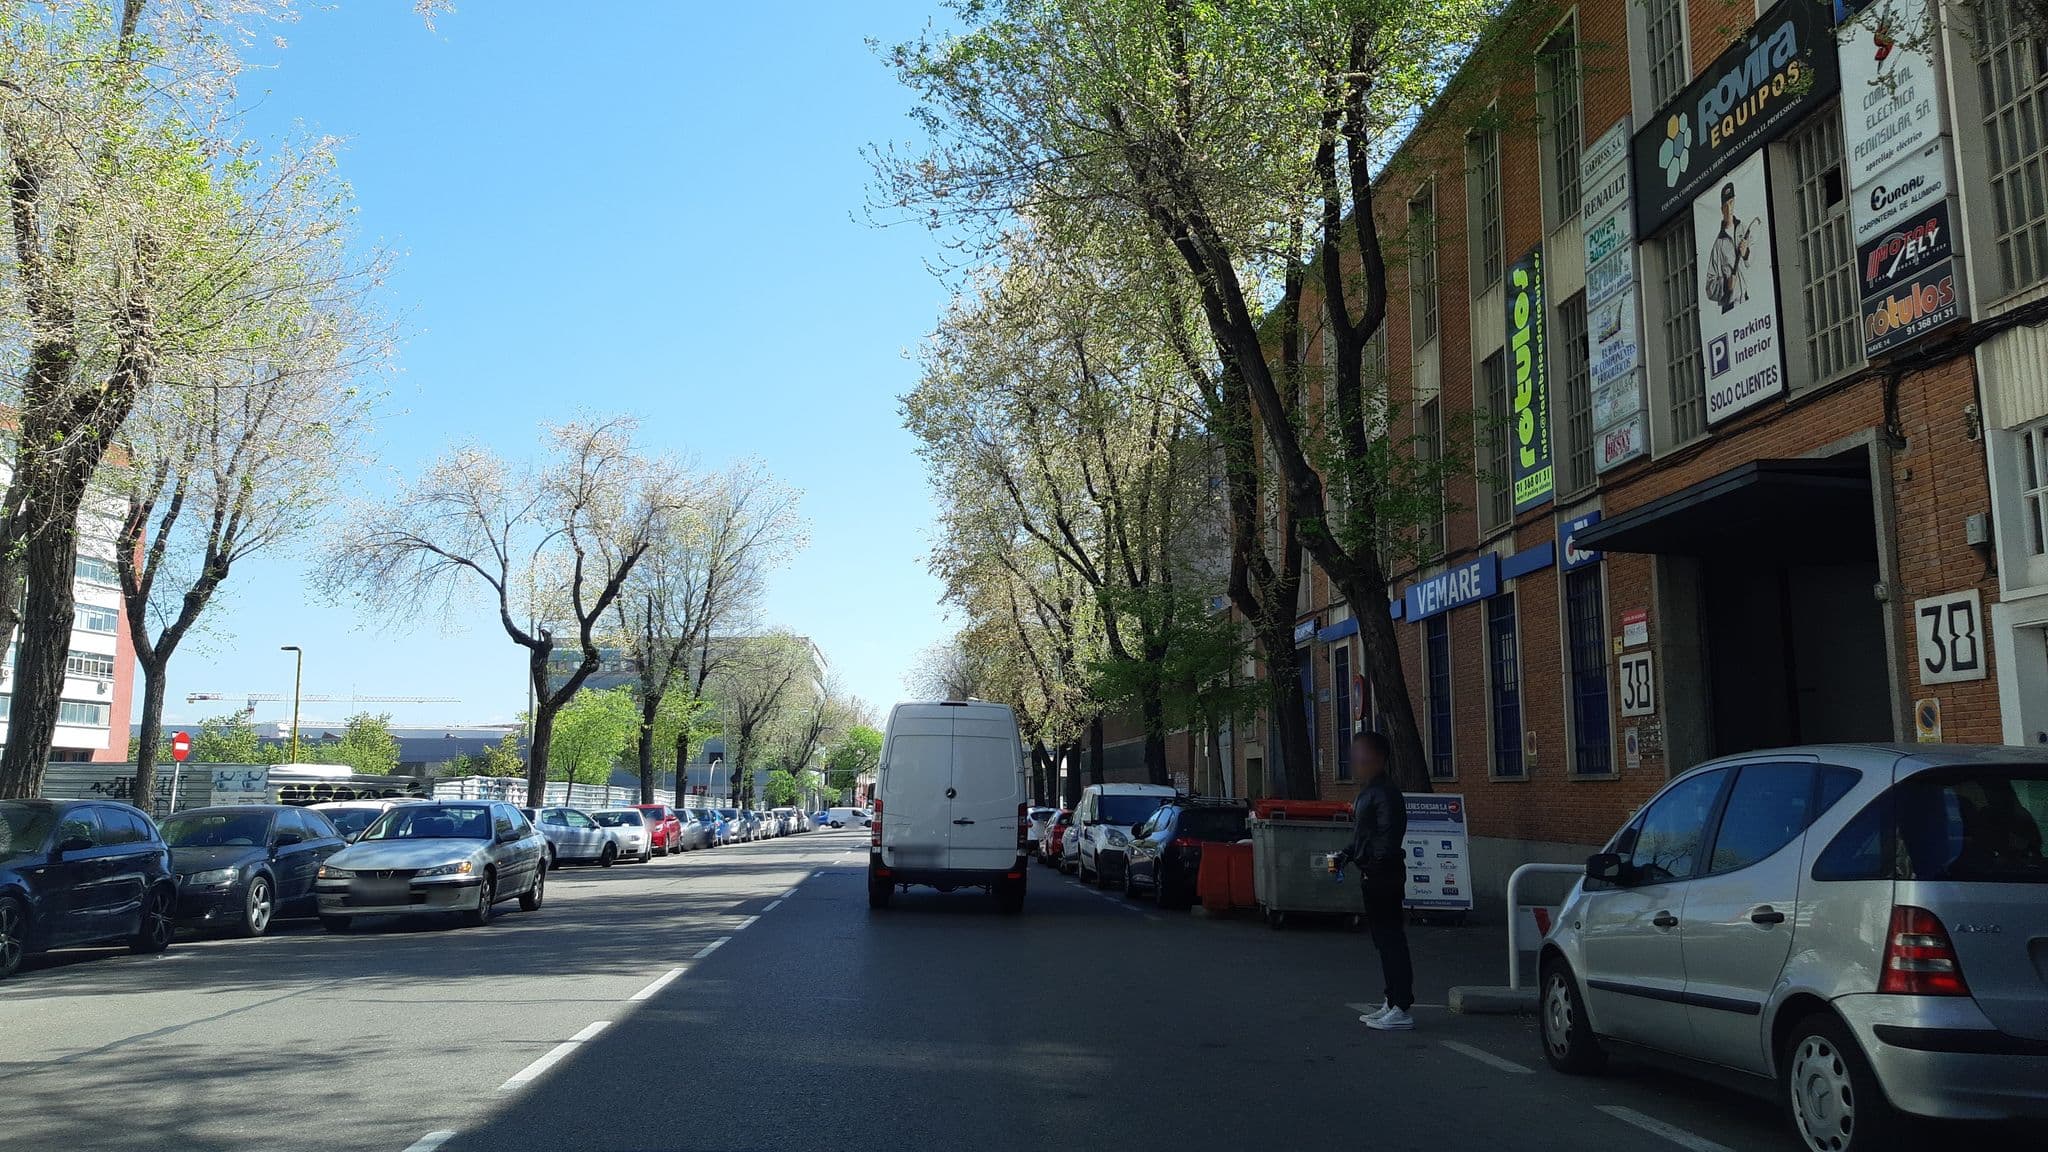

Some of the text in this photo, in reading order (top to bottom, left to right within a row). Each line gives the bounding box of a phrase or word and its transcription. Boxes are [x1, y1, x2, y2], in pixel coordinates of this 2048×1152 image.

[1711, 60, 1800, 149] EQUIPOS
[1864, 66, 1913, 111] COMEIAL
[1584, 173, 1626, 220] RENAULT
[1899, 200, 1908, 211] DE
[1911, 181, 1942, 204] ALUMINIO
[1733, 314, 1771, 343] Parking
[1865, 275, 1955, 342] rótulos
[1906, 307, 1954, 336] 91 368 01 31
[1712, 340, 1726, 374] P
[1735, 336, 1771, 364] Interior
[1711, 364, 1778, 412] SOLO CLIENTES
[1417, 563, 1481, 615] VEMARE
[1921, 600, 1978, 674] 38
[1622, 659, 1650, 709] 38
